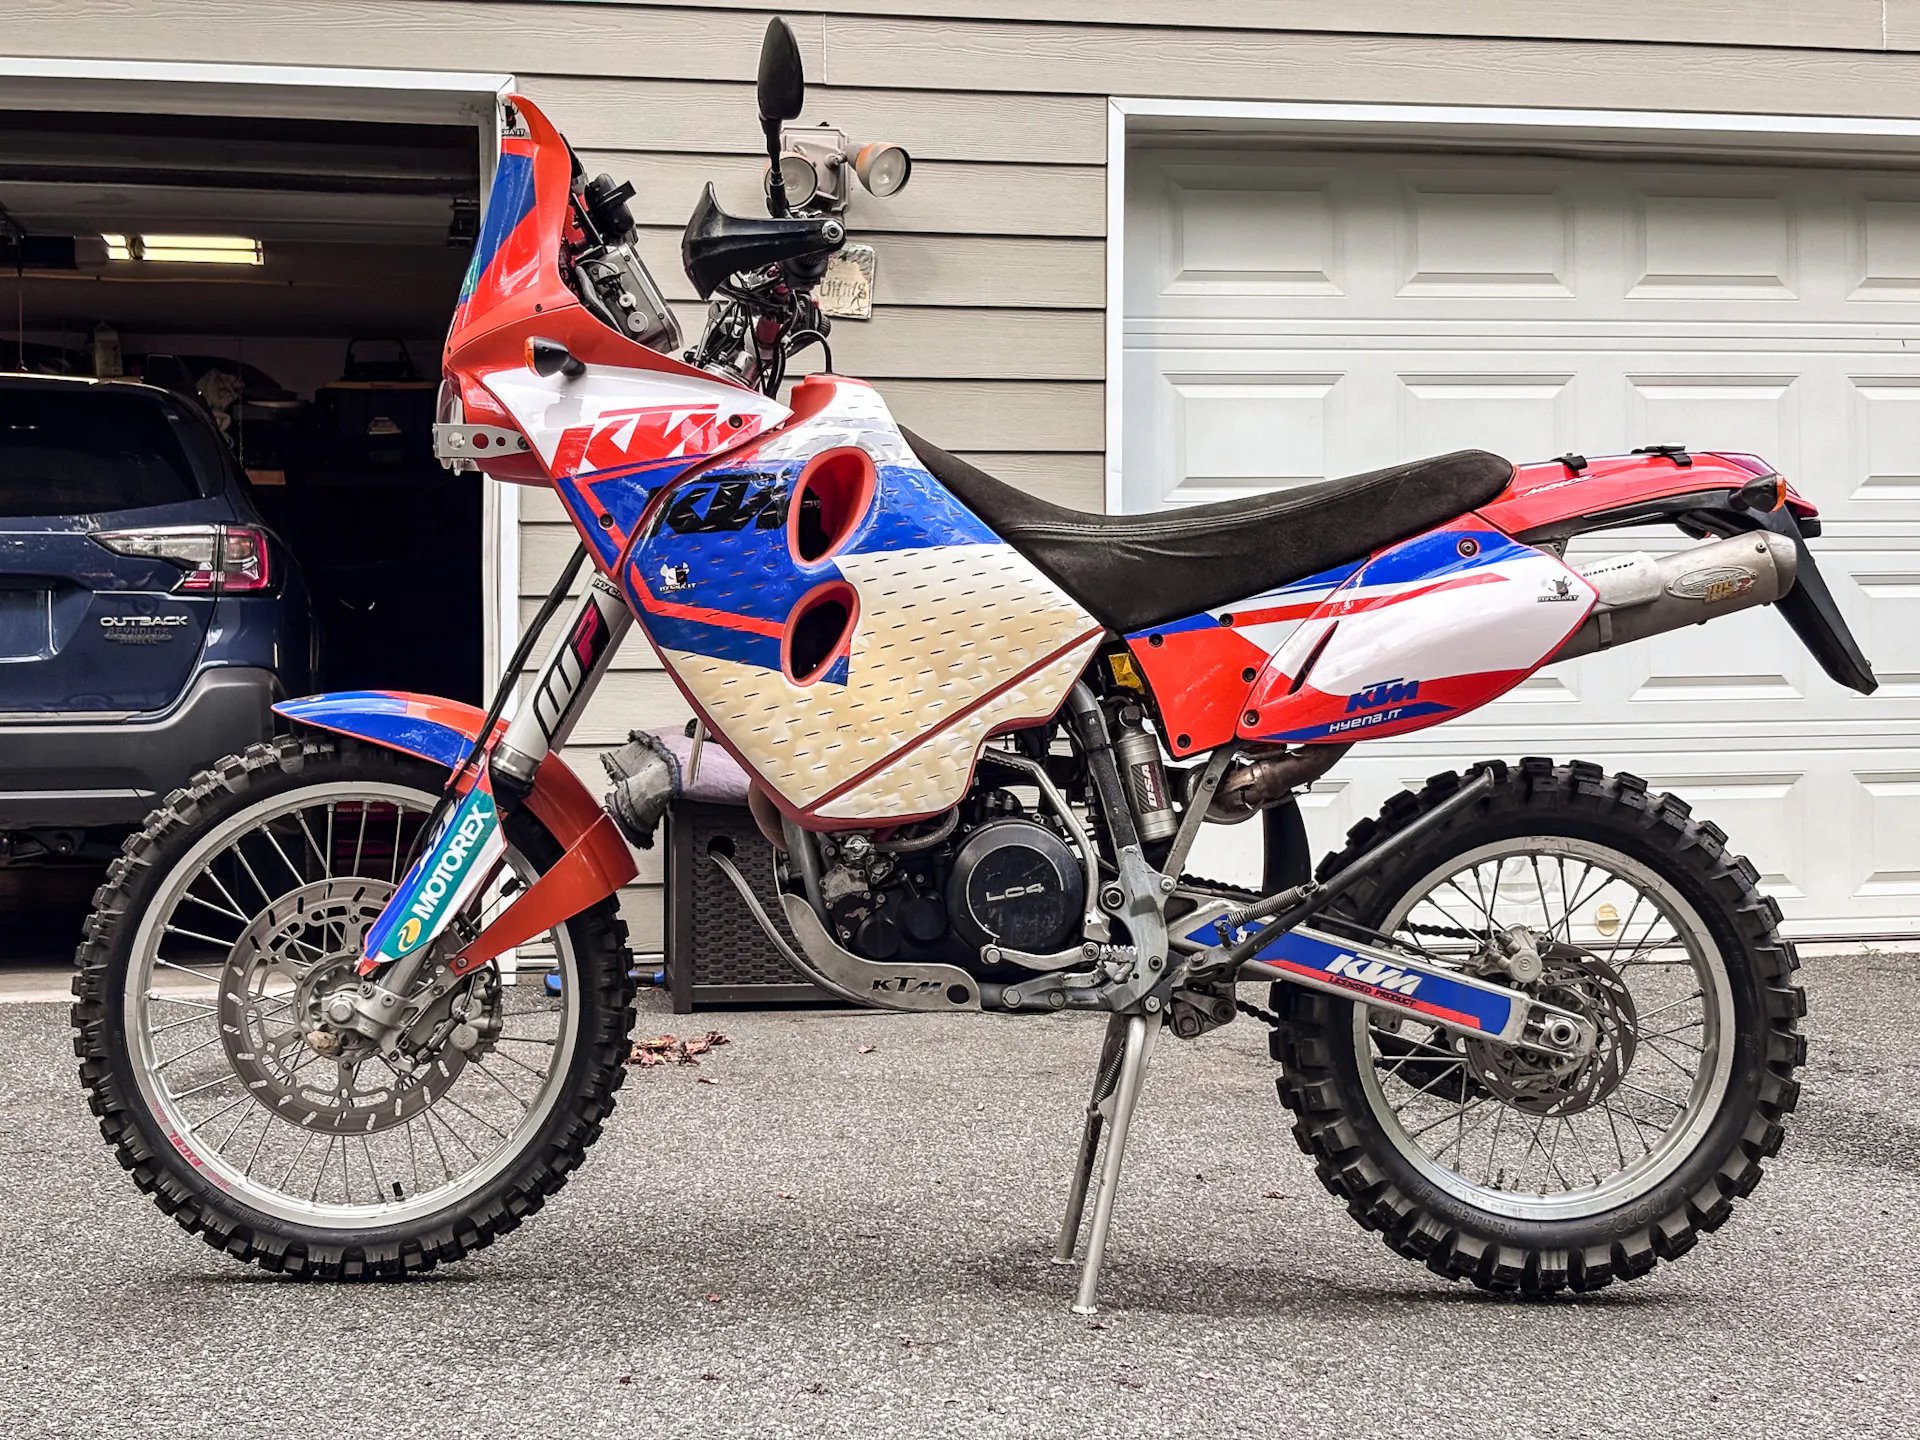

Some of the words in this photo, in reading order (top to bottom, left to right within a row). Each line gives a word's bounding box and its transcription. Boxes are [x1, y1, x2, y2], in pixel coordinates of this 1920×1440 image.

[550, 404, 762, 475] KTM
[1582, 567, 1609, 577] GIANT
[1612, 561, 1635, 571] LOOP
[100, 615, 188, 627] OUTBACK
[1345, 678, 1419, 713] KTM
[410, 803, 493, 919] MOTOREX
[986, 882, 1045, 902] LC4
[871, 976, 944, 995] KTM
[1324, 952, 1423, 996] KTM
[1328, 975, 1372, 995] LICENSED
[1374, 988, 1417, 1007] PRODUCT
[168, 1129, 203, 1168] EXCEL
